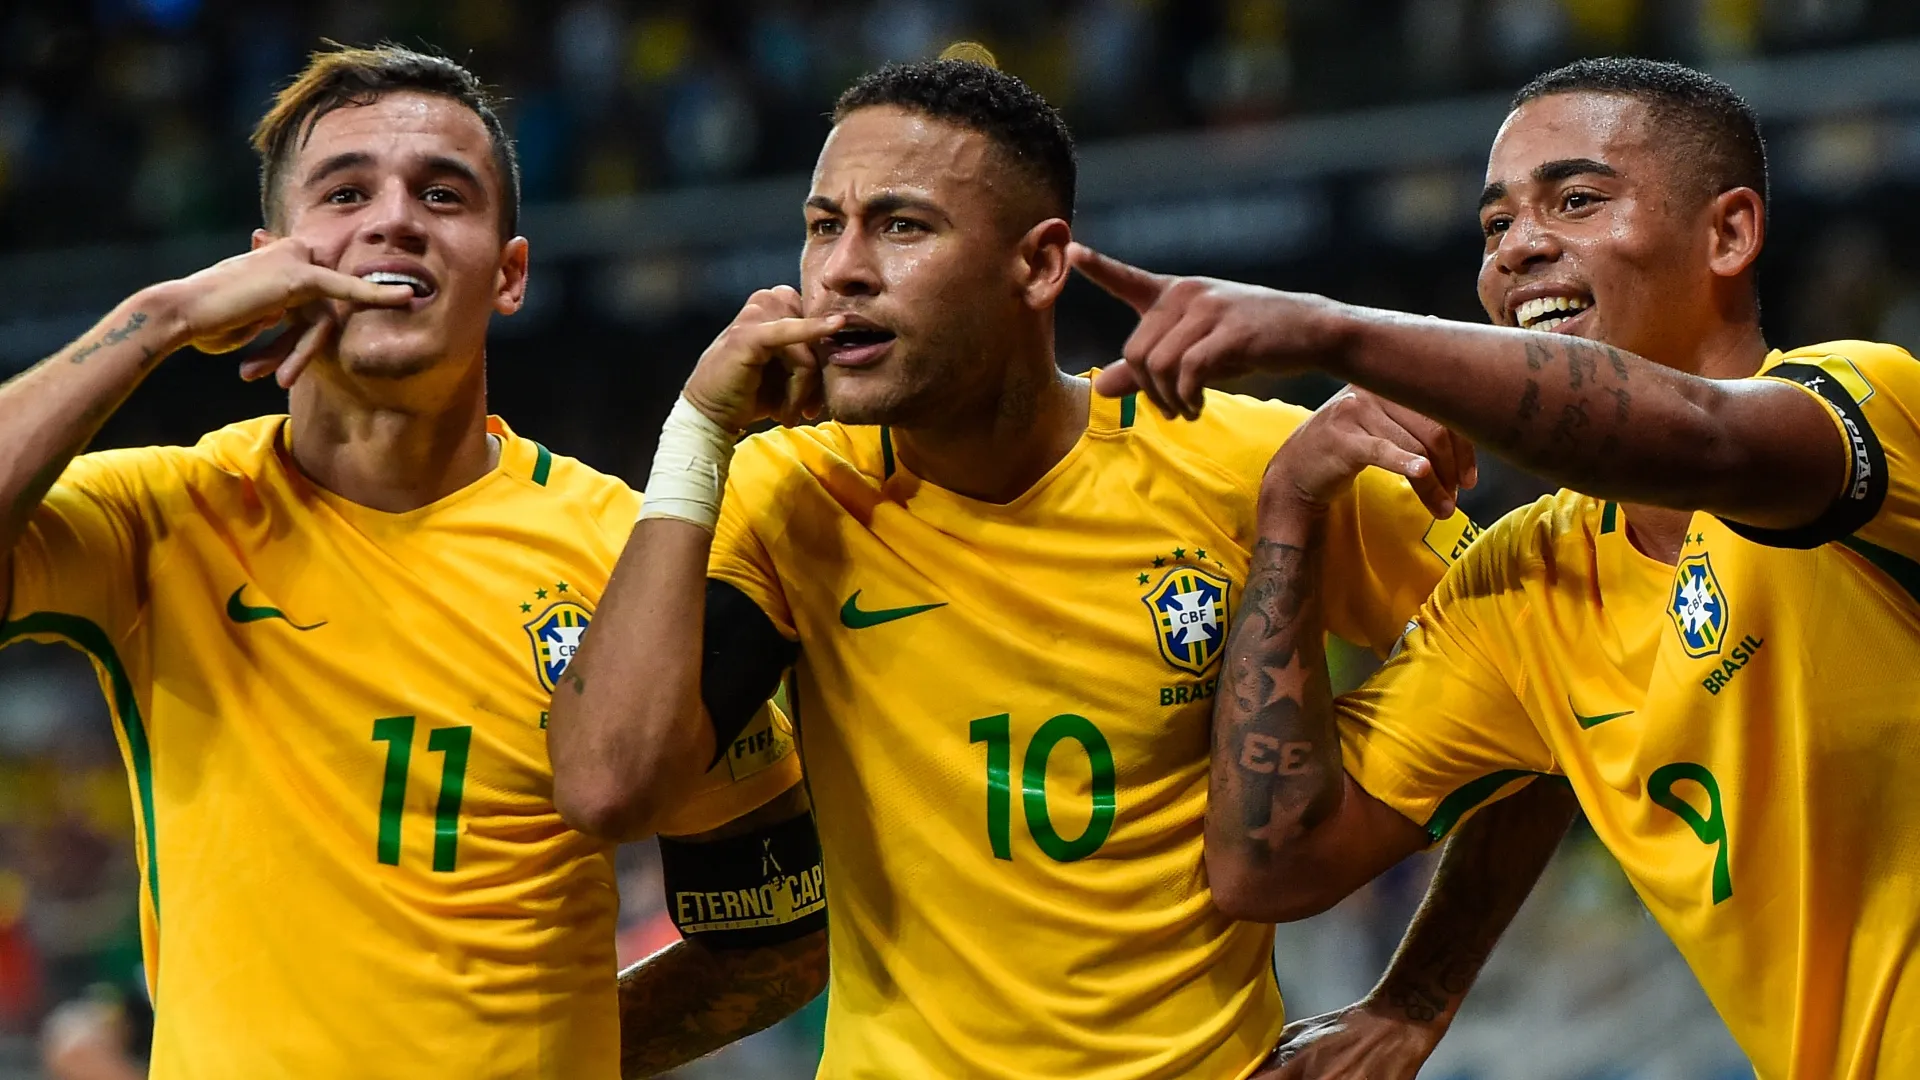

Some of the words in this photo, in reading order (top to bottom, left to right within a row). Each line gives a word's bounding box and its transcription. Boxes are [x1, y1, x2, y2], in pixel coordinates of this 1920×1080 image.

[1179, 609, 1207, 625] CBF
[1687, 591, 1703, 616] CBF
[559, 645, 577, 657] CB
[1702, 635, 1764, 695] BRASIL
[1160, 683, 1216, 706] BRAS
[372, 716, 472, 872] 11
[970, 713, 1116, 862] 10
[1647, 762, 1733, 905] 9
[676, 884, 774, 924] ETERNO
[786, 862, 824, 909] CAP
